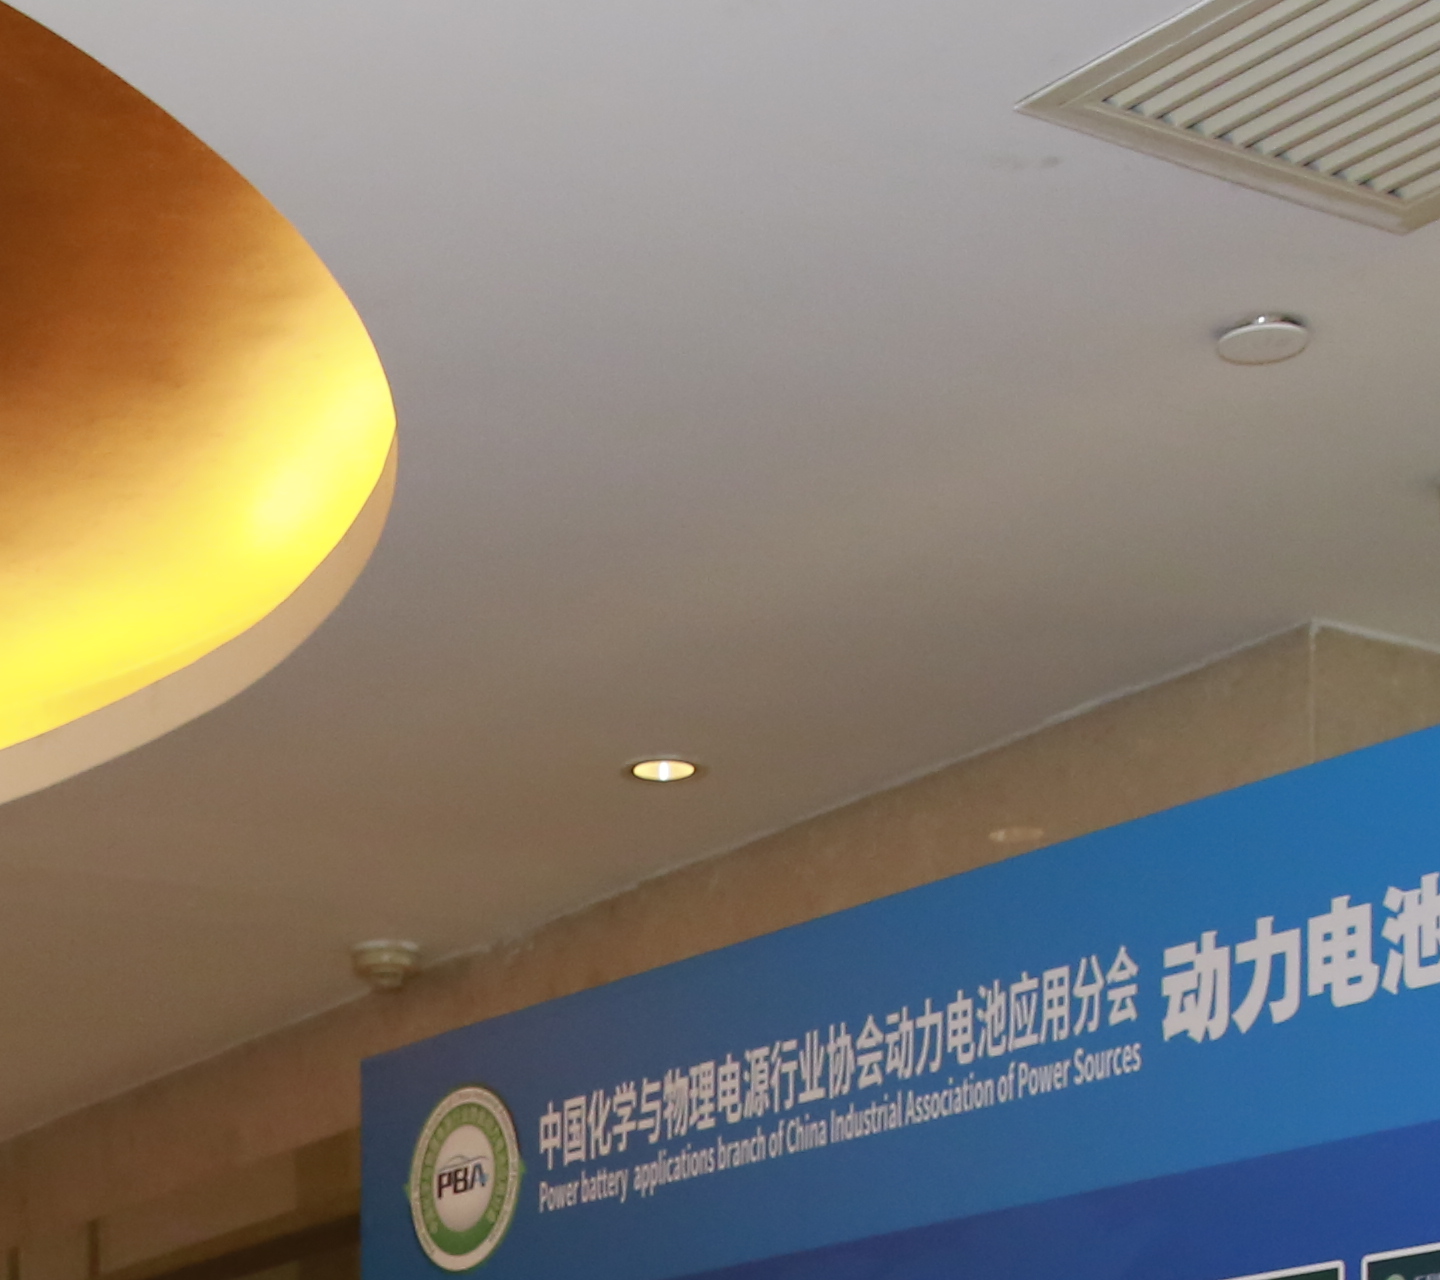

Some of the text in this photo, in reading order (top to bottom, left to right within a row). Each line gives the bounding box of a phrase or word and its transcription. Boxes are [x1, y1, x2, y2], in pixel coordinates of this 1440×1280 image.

[537, 945, 1139, 1171] 中国化学与物理电源行业协会动力电池应用分会
[538, 1042, 1142, 1213] Power battery applications branch of China Industrial Association of Power Sources
[437, 1163, 489, 1199] PBA
